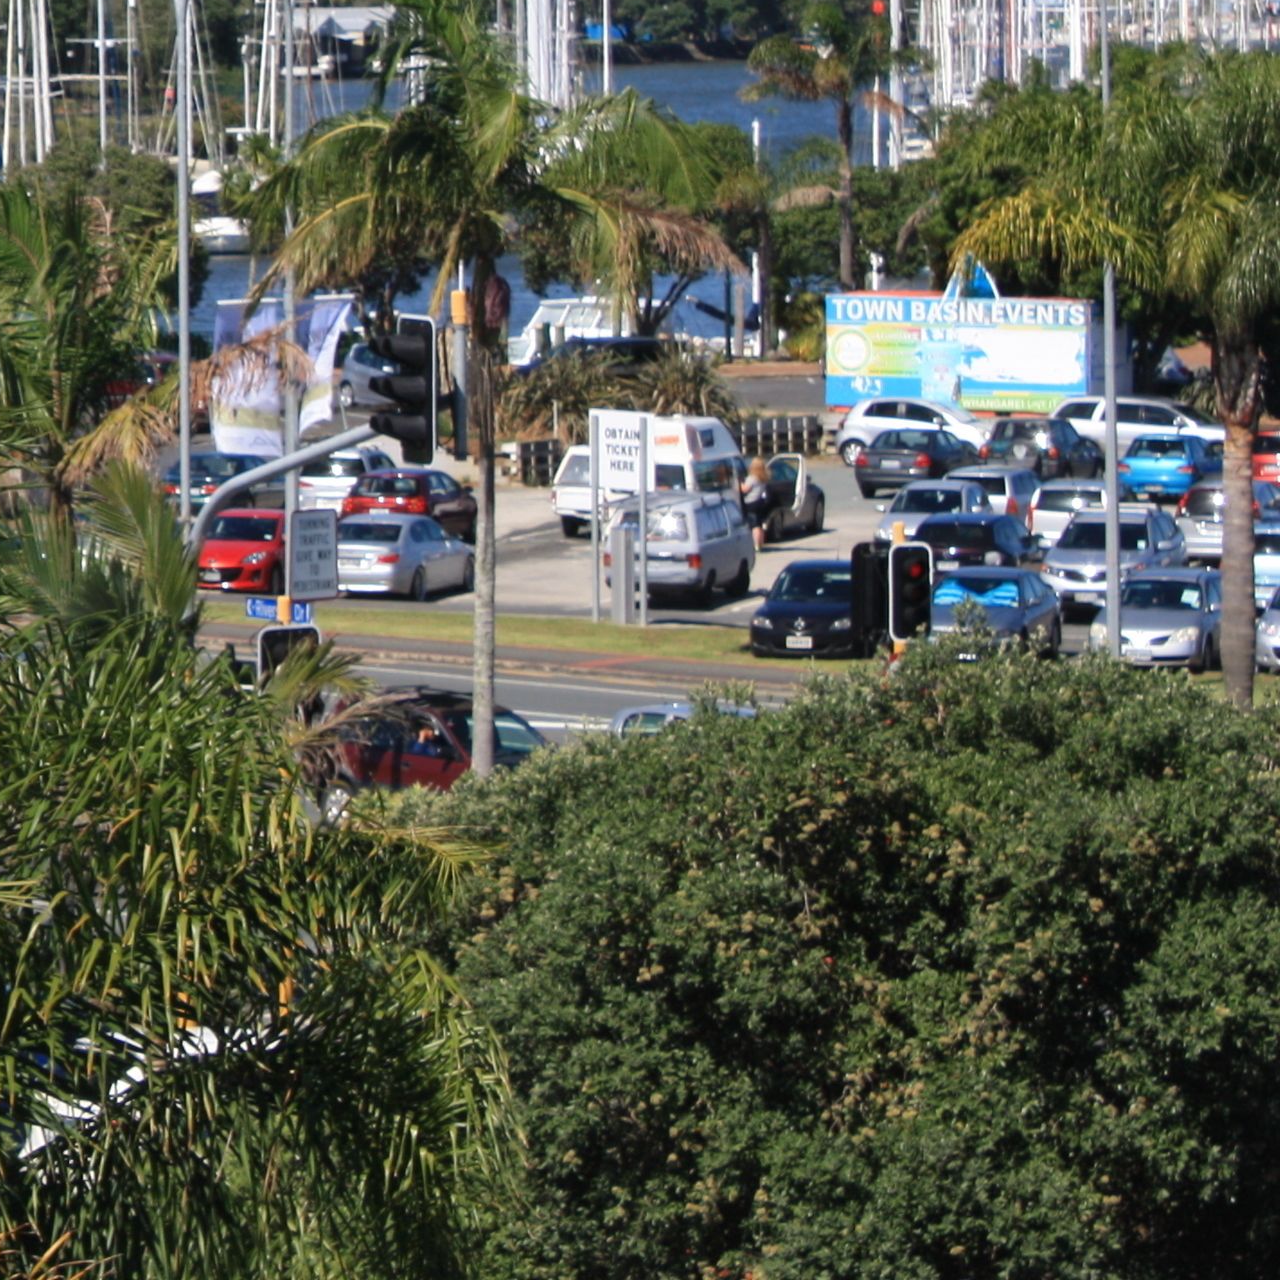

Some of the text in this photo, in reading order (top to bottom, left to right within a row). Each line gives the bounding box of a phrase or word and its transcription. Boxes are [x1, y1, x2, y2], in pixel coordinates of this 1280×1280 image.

[832, 299, 1085, 325] TOWN BASIN EVENTS
[604, 427, 640, 441] OBTAIN
[606, 444, 640, 457] TICKET
[609, 459, 635, 472] HERE
